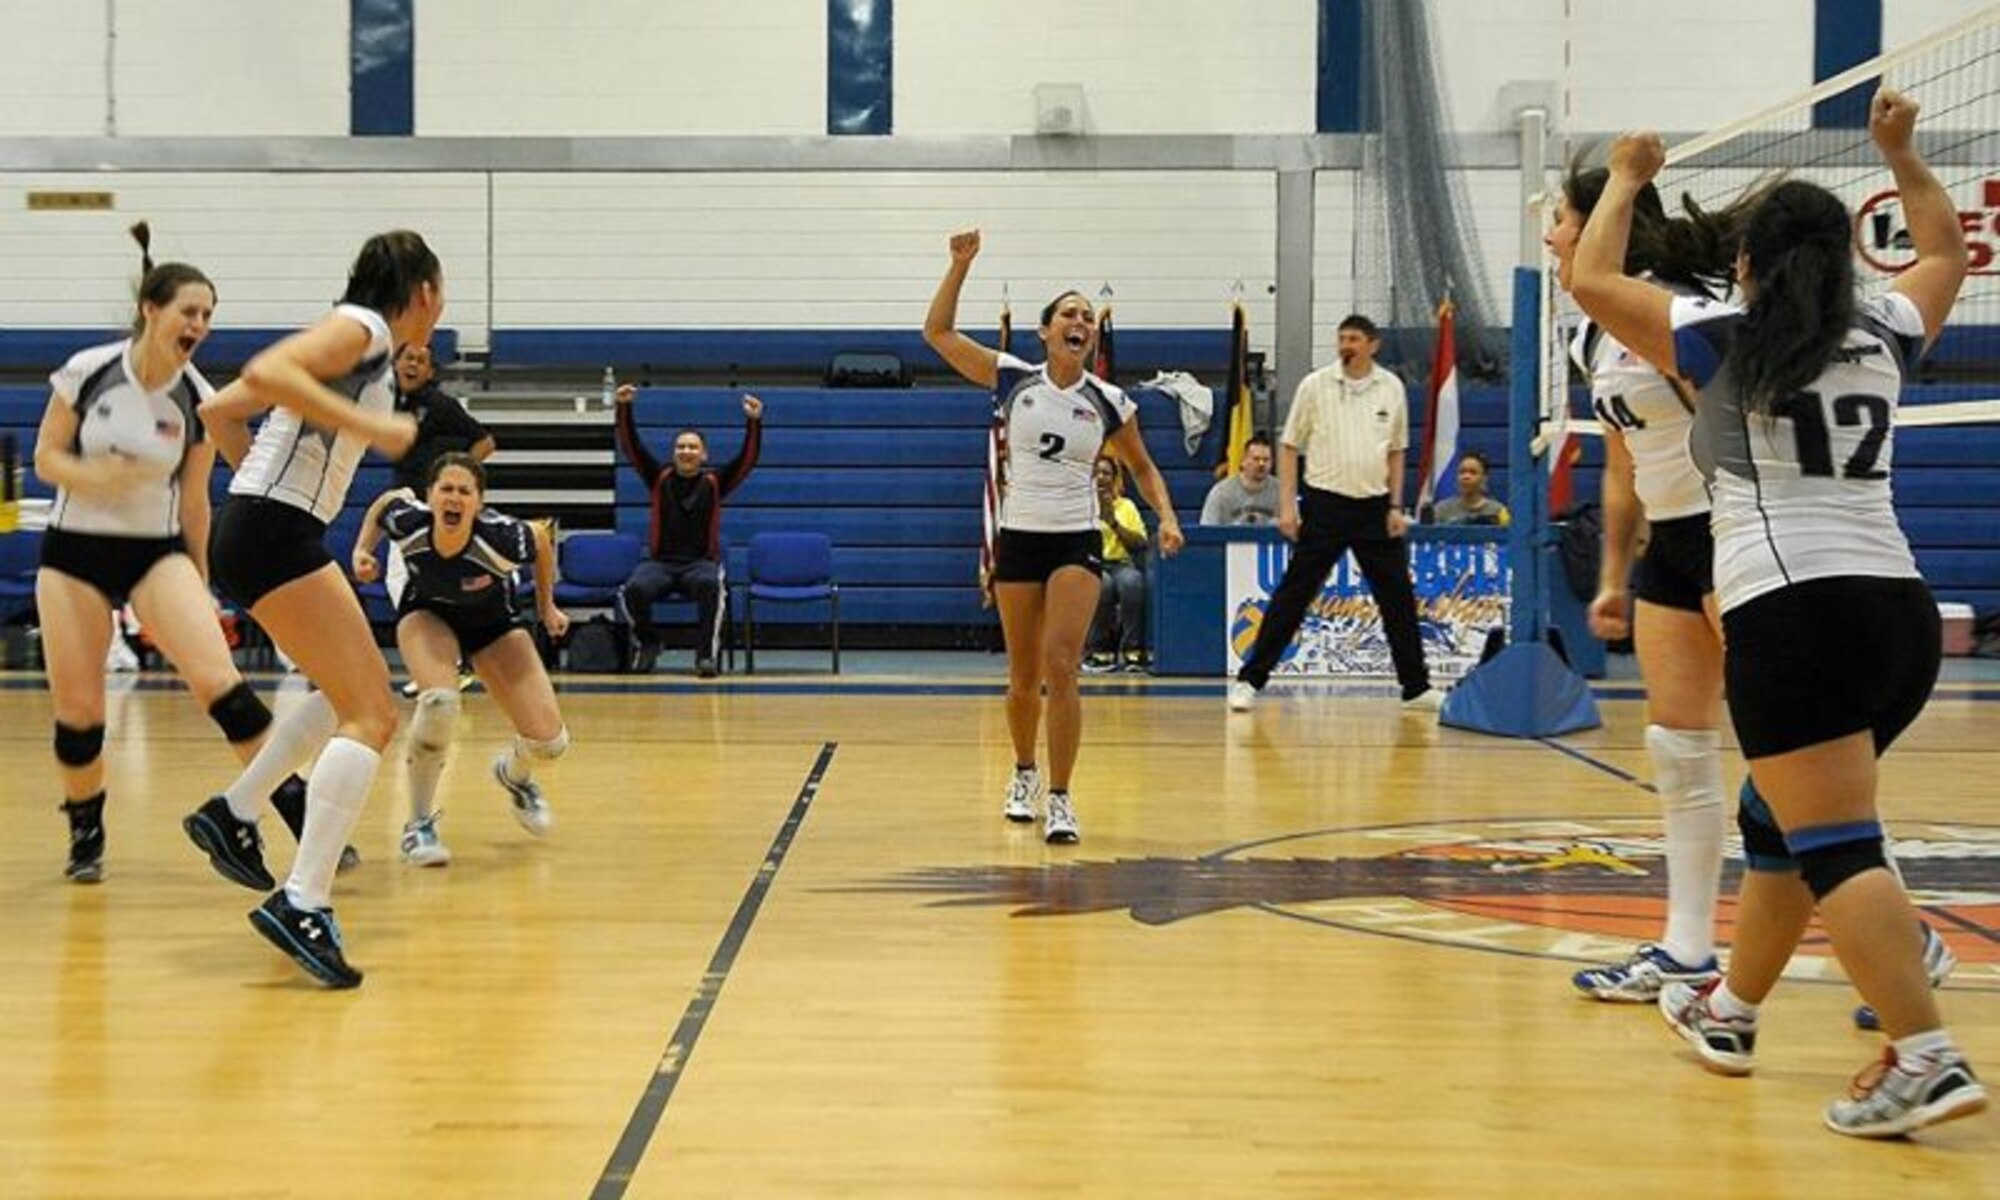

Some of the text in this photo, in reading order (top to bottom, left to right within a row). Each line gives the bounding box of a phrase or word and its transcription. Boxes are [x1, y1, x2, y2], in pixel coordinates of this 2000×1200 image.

[1594, 394, 1646, 431] 14
[1039, 431, 1066, 463] 2
[1770, 391, 1889, 479] 12
